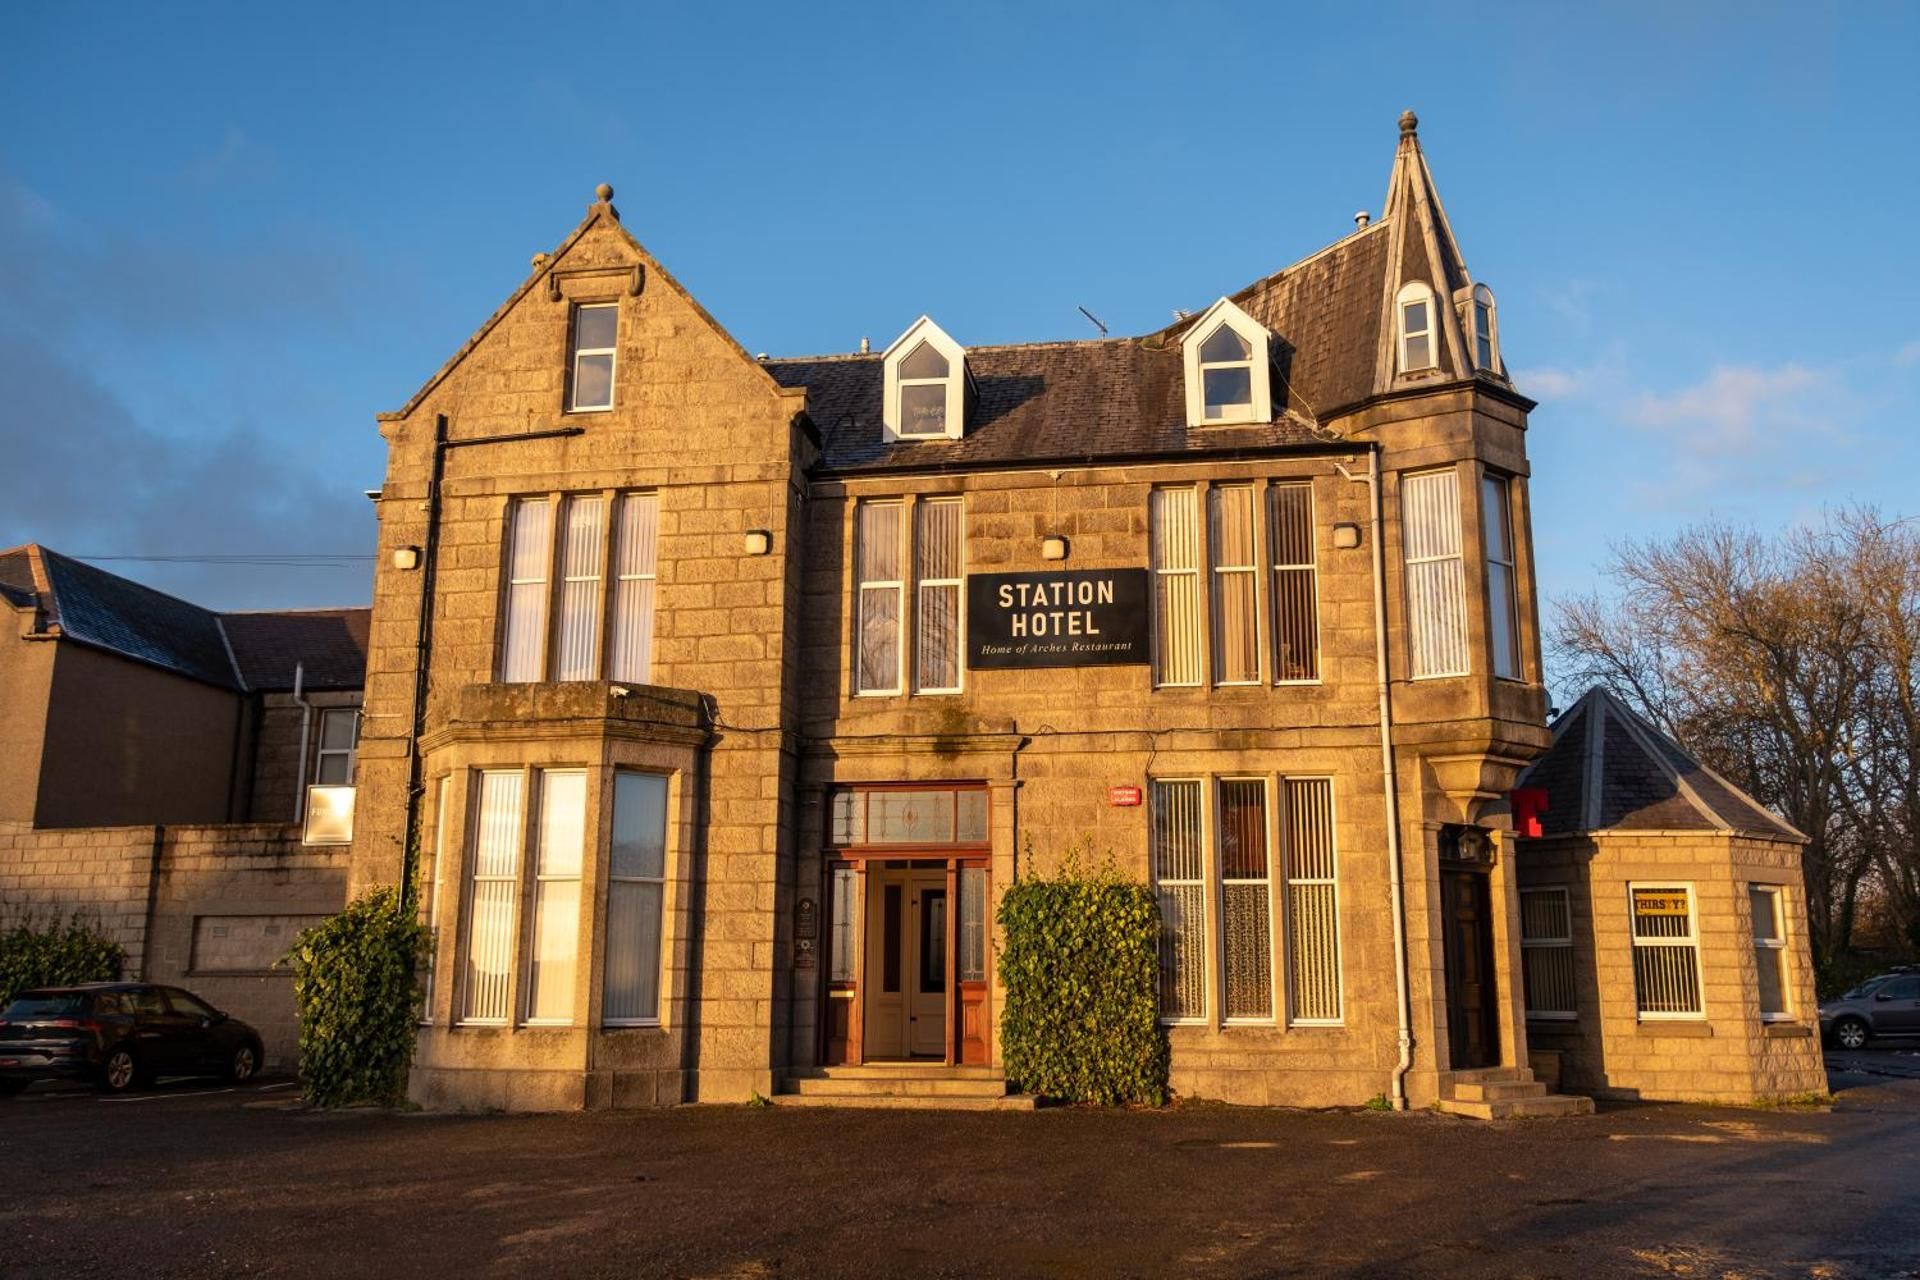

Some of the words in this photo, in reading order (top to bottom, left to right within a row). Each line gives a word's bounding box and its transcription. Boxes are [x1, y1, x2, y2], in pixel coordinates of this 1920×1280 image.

[998, 580, 1114, 608] STATION
[1011, 611, 1100, 637] HOTEL
[981, 645, 1012, 655] Home
[1015, 644, 1029, 655] of
[1030, 642, 1067, 653] Arches
[1071, 641, 1132, 652] Restaurant
